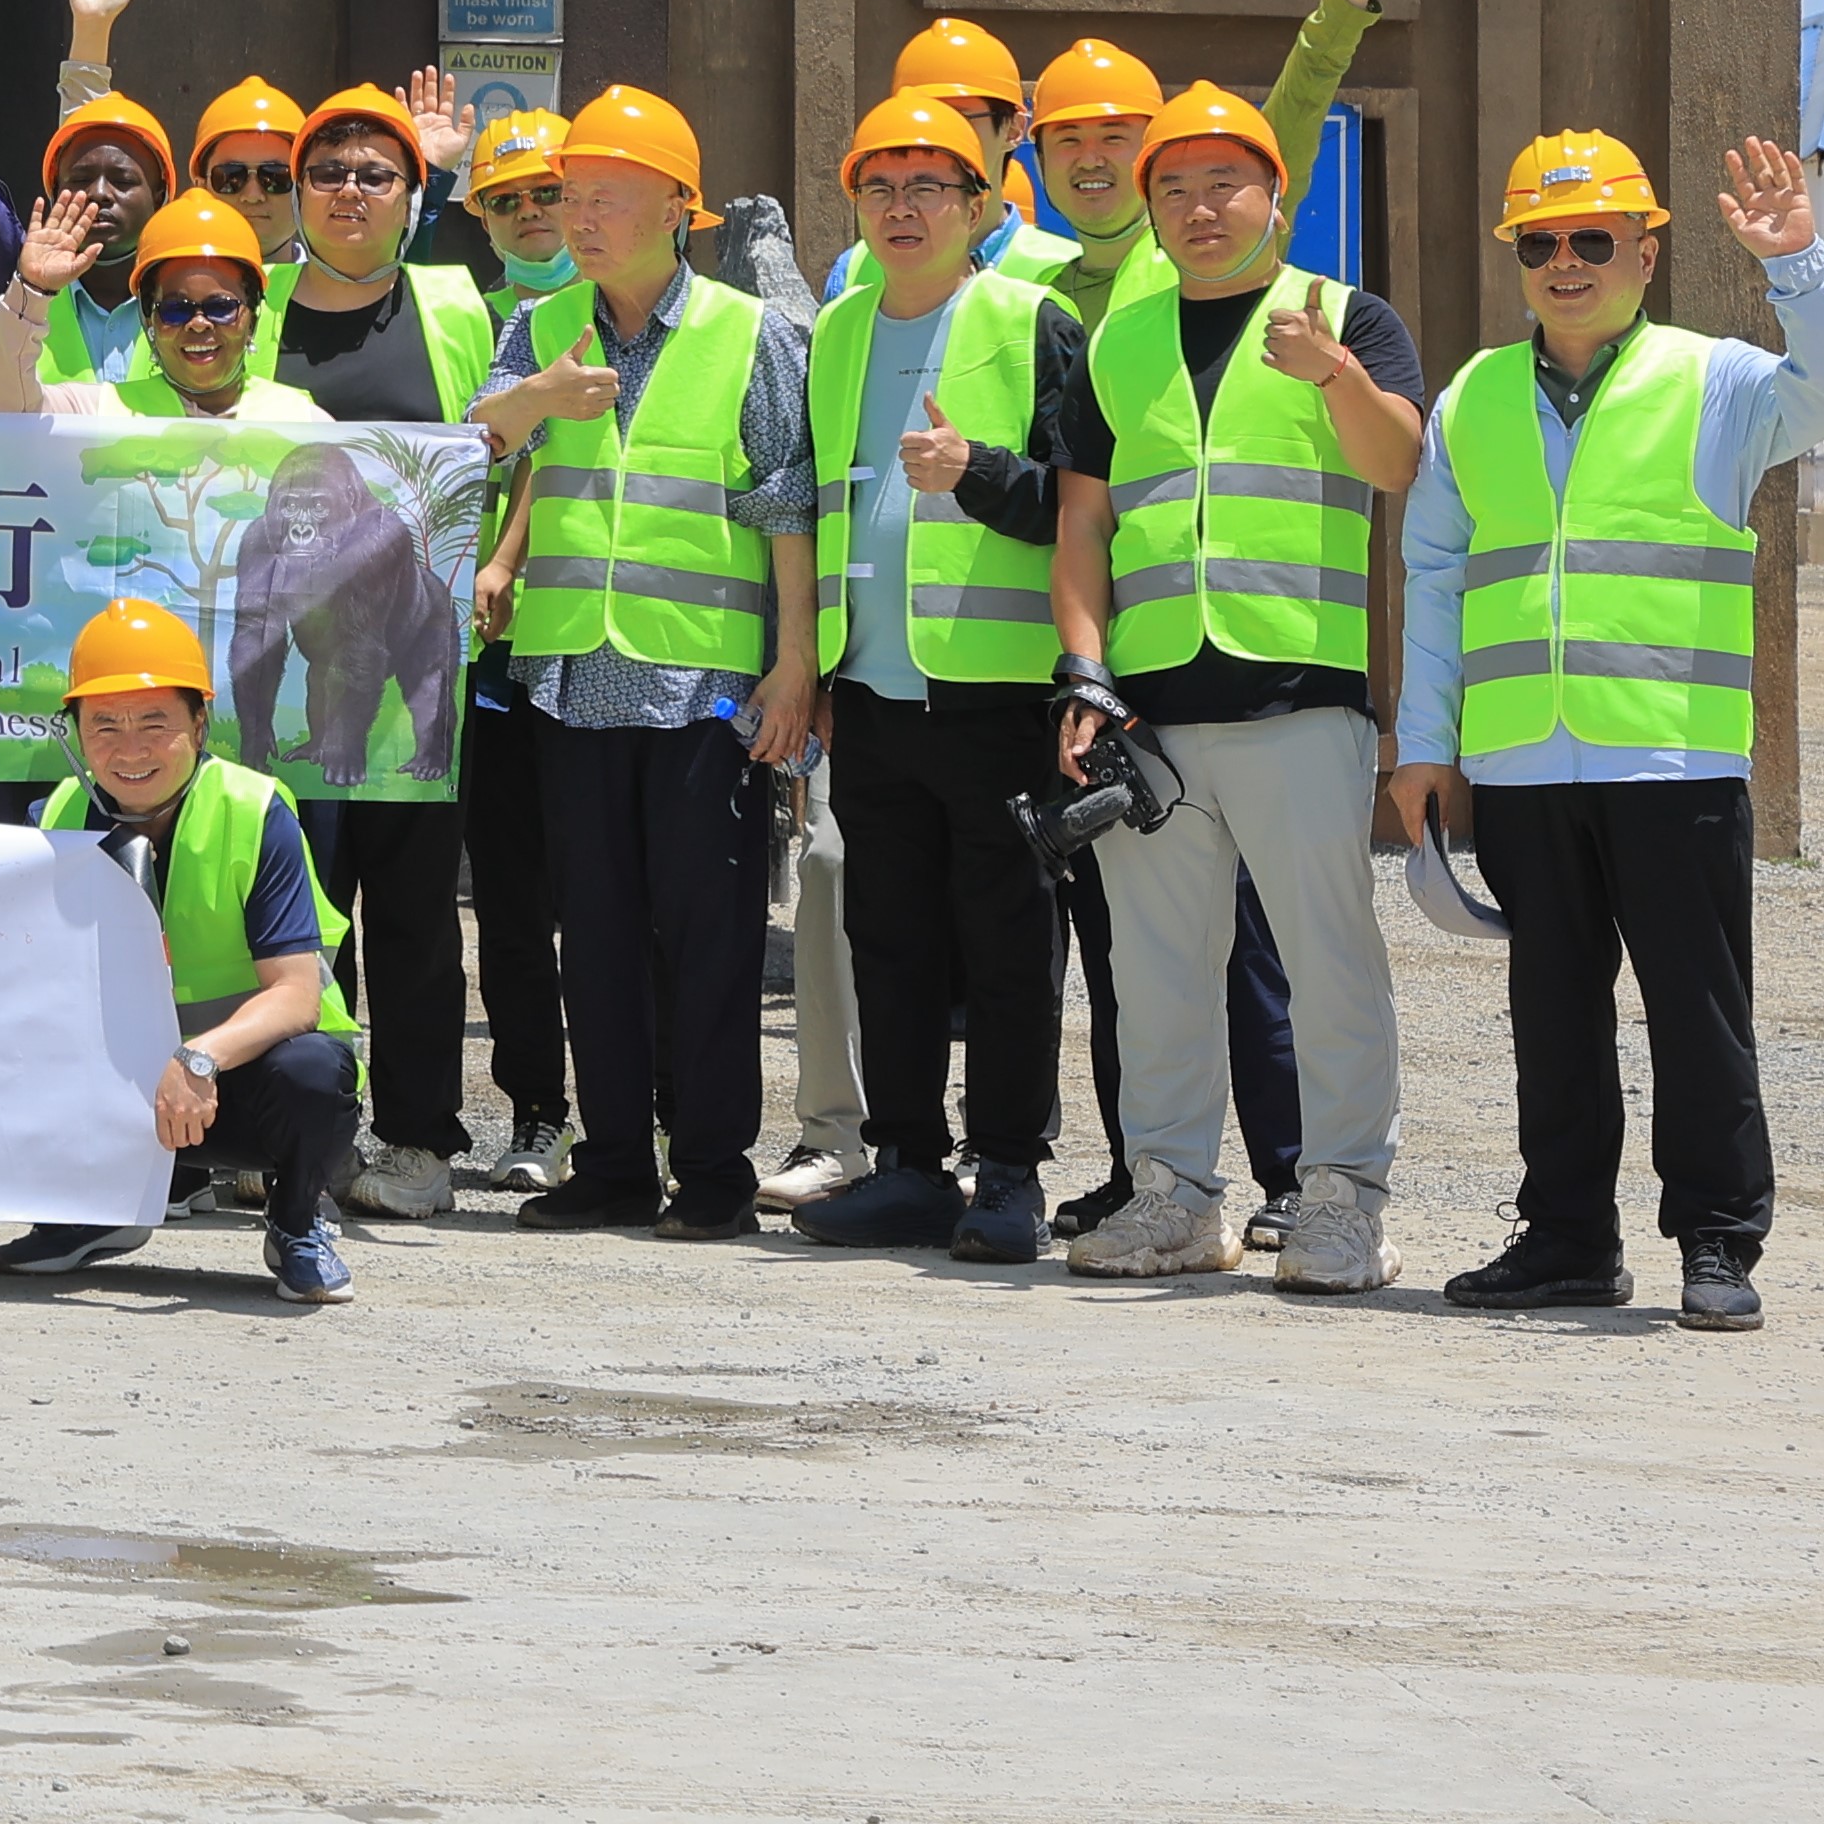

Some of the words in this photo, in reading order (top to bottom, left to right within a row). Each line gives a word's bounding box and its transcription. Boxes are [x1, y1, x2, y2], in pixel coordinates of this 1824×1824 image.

[467, 12, 488, 25] be
[492, 13, 535, 26] worn
[470, 53, 547, 71] CAUTION
[1074, 684, 1129, 720] SONY
